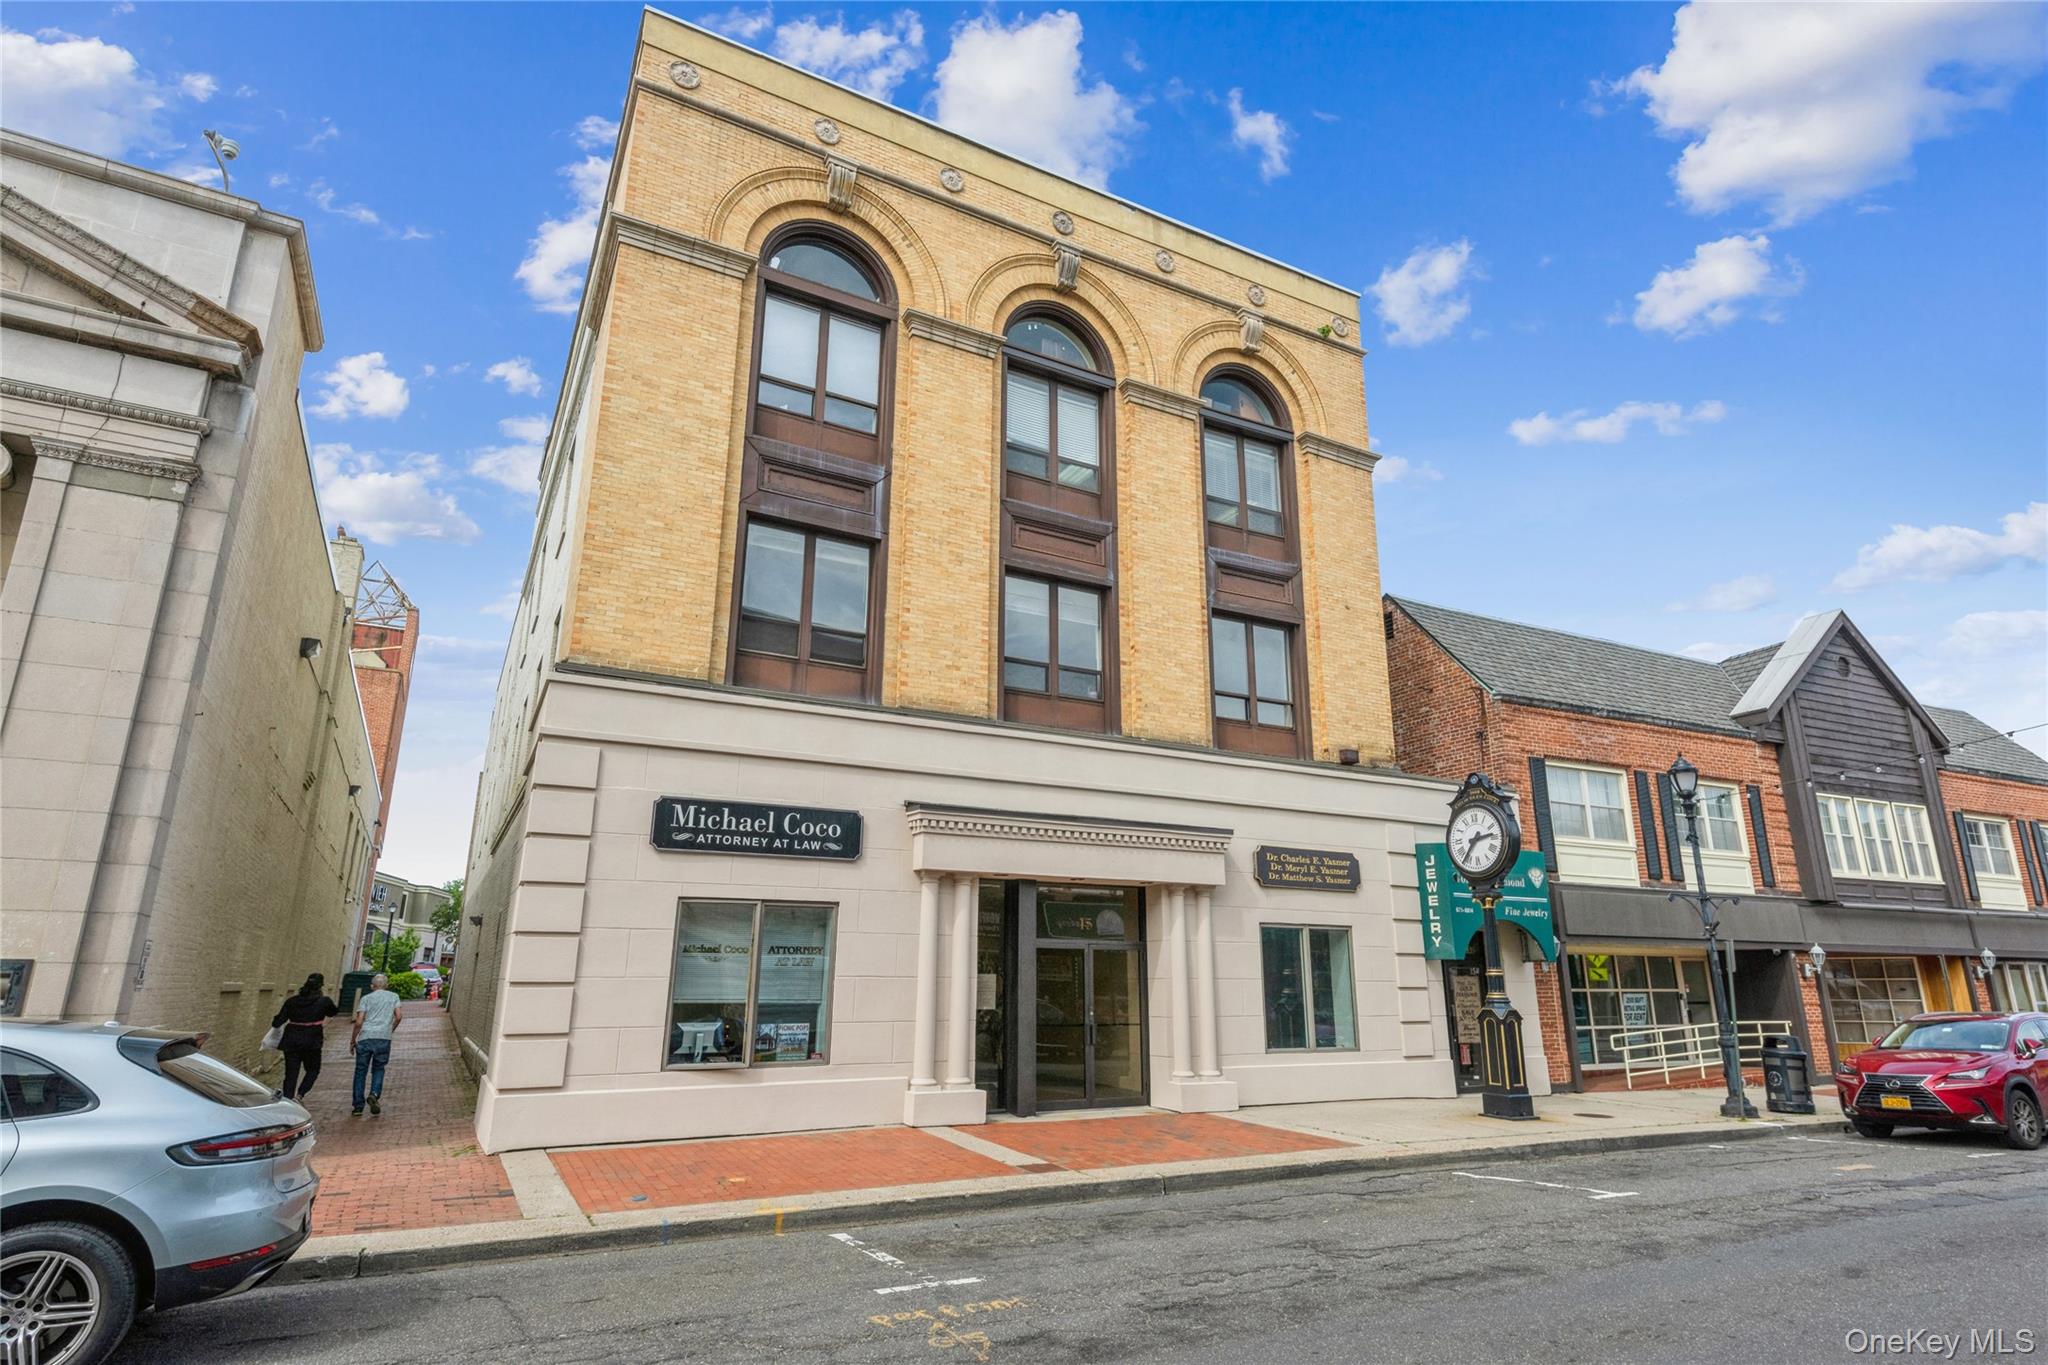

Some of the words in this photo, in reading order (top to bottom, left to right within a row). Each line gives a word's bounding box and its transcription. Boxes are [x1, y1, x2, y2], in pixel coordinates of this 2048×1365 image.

[670, 803, 775, 834] Michael
[783, 812, 842, 838] Coco
[696, 834, 769, 848] ATTORNEY
[773, 838, 790, 849] AT
[794, 840, 822, 850] LAW
[1266, 852, 1279, 861] Dr.
[1280, 853, 1310, 864] Charles
[1270, 863, 1283, 871] Dr.
[1285, 863, 1308, 874] Meryl
[1310, 866, 1318, 874] E.
[1268, 872, 1280, 880] Dr.
[1282, 873, 1315, 882] Matthew
[1425, 854, 1442, 948] JEWELRY
[1504, 906, 1521, 916] Fine
[1522, 908, 1548, 919] Jewelry
[767, 945, 824, 955] ATTORNEY
